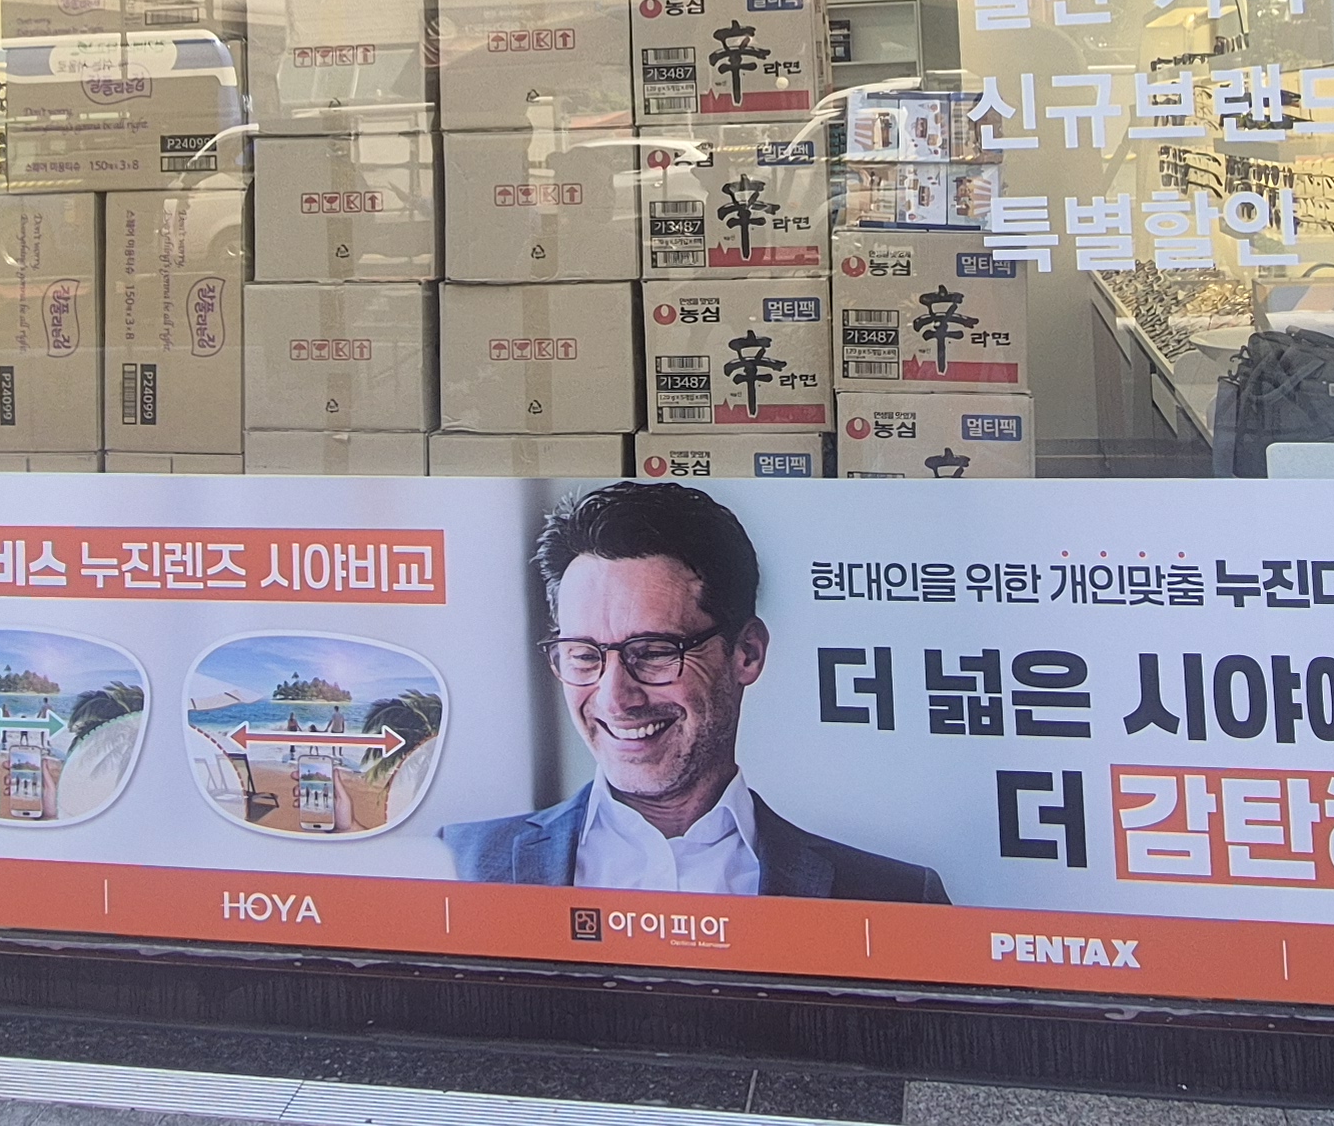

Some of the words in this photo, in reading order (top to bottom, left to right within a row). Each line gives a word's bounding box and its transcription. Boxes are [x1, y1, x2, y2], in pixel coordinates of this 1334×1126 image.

[709, 19, 771, 104] 辛
[763, 61, 801, 77] 라면
[717, 173, 781, 259] 辛
[772, 216, 811, 232] 라면
[983, 190, 1300, 273] 특별할인
[868, 259, 911, 276] 농심
[49, 286, 71, 349] 잘풀리는집
[195, 284, 216, 349] 잘풀리는집
[679, 306, 720, 323] 농심
[768, 301, 815, 319] 멀티팩
[913, 284, 979, 373] 辛
[971, 331, 1011, 347] 라면
[3, 373, 12, 420] P24099
[143, 371, 154, 419] P24099
[724, 330, 787, 415] 辛
[779, 373, 818, 390] 라면
[874, 421, 916, 438] 농심
[967, 418, 1017, 437] 멀티팩
[670, 459, 710, 477] 농심
[759, 456, 806, 474] 멀티팩
[81, 541, 247, 590] 누진렌즈
[260, 543, 435, 593] 시야비교
[811, 559, 957, 603] 현대인을
[966, 561, 1041, 604] 위한
[1050, 561, 1205, 608] 개인맞춤
[818, 647, 895, 731] 더
[924, 648, 1093, 739] 넓은
[996, 770, 1089, 870] 더
[221, 892, 321, 924] HOYA
[608, 911, 729, 942] 아이피아
[991, 932, 1141, 970] PENTAX
